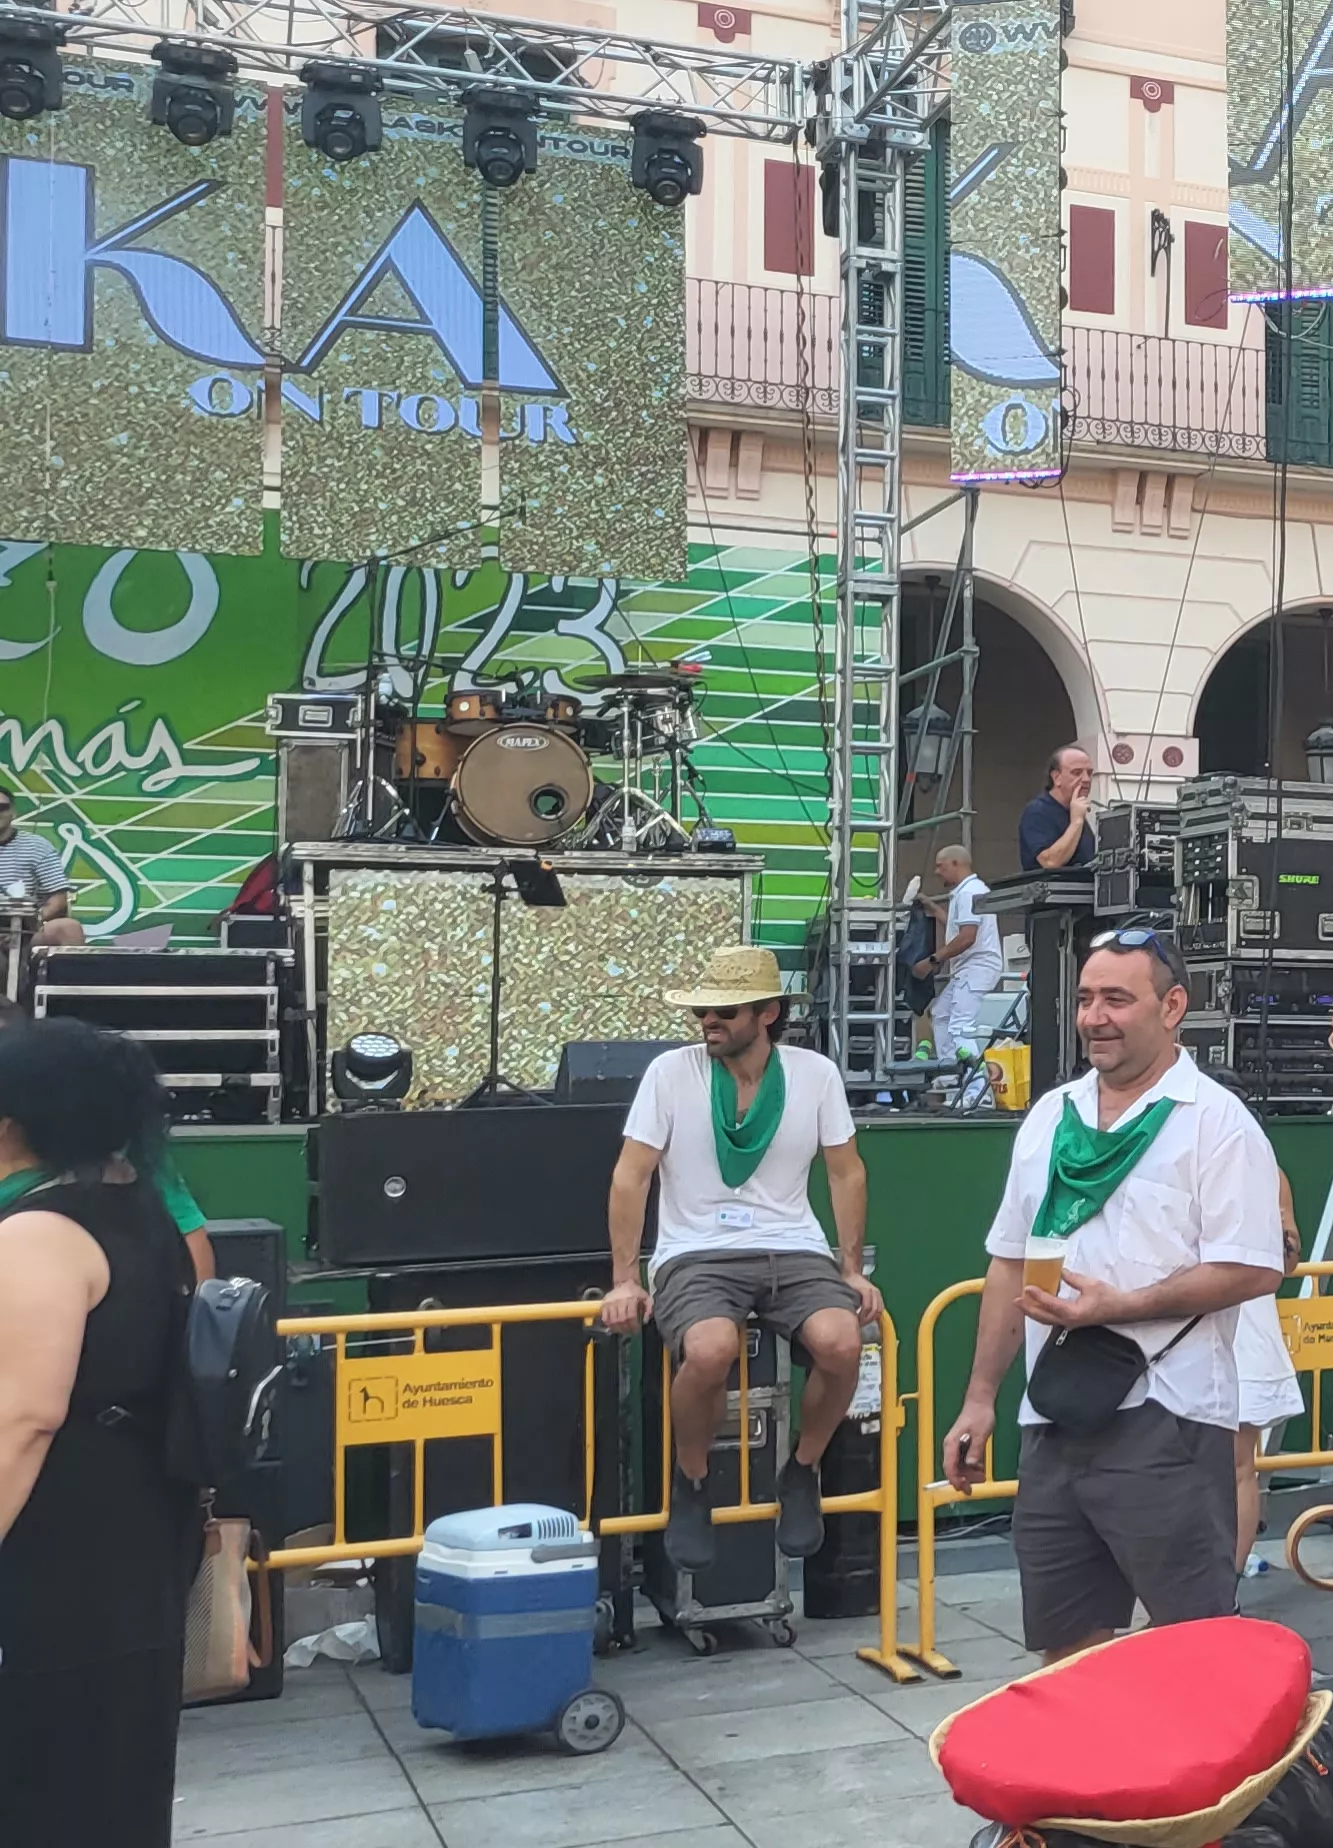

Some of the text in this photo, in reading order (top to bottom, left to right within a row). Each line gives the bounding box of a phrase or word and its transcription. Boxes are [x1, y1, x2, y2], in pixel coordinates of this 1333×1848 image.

[187, 372, 578, 446] ON TOUR
[504, 737, 541, 747] MAPEX
[1278, 874, 1320, 885] SHURE
[402, 1377, 494, 1396] Ayuntamiento
[402, 1394, 473, 1409] de Huesca
